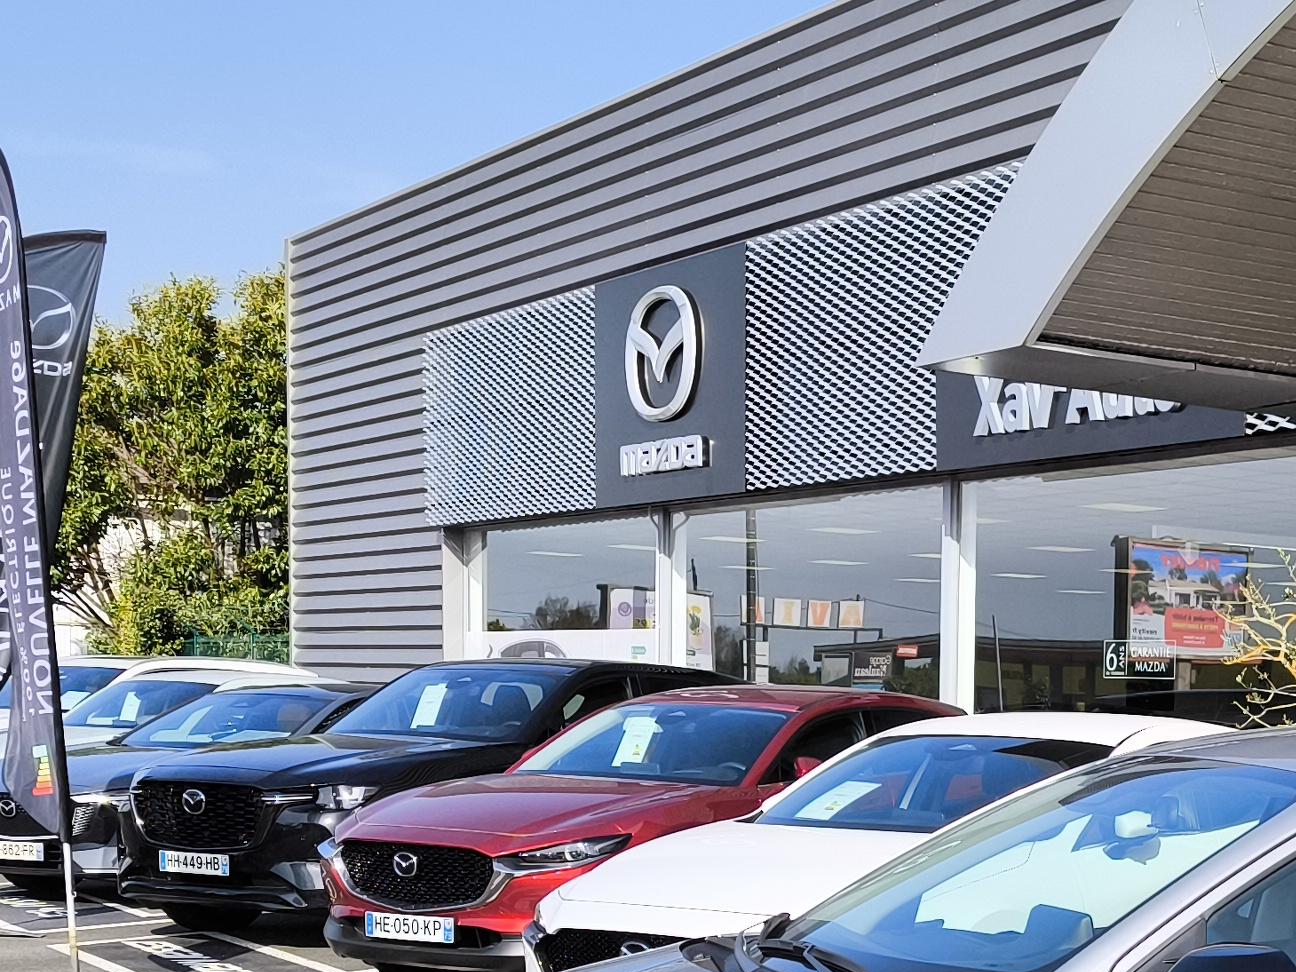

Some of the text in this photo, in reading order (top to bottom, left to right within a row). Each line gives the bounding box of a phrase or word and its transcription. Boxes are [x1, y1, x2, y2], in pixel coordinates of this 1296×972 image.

[620, 434, 705, 477] mazda
[1106, 643, 1117, 671] 6
[1131, 647, 1171, 658] GARANTIE
[1135, 661, 1167, 672] MAZDA
[374, 915, 442, 936] HE-050-KP
